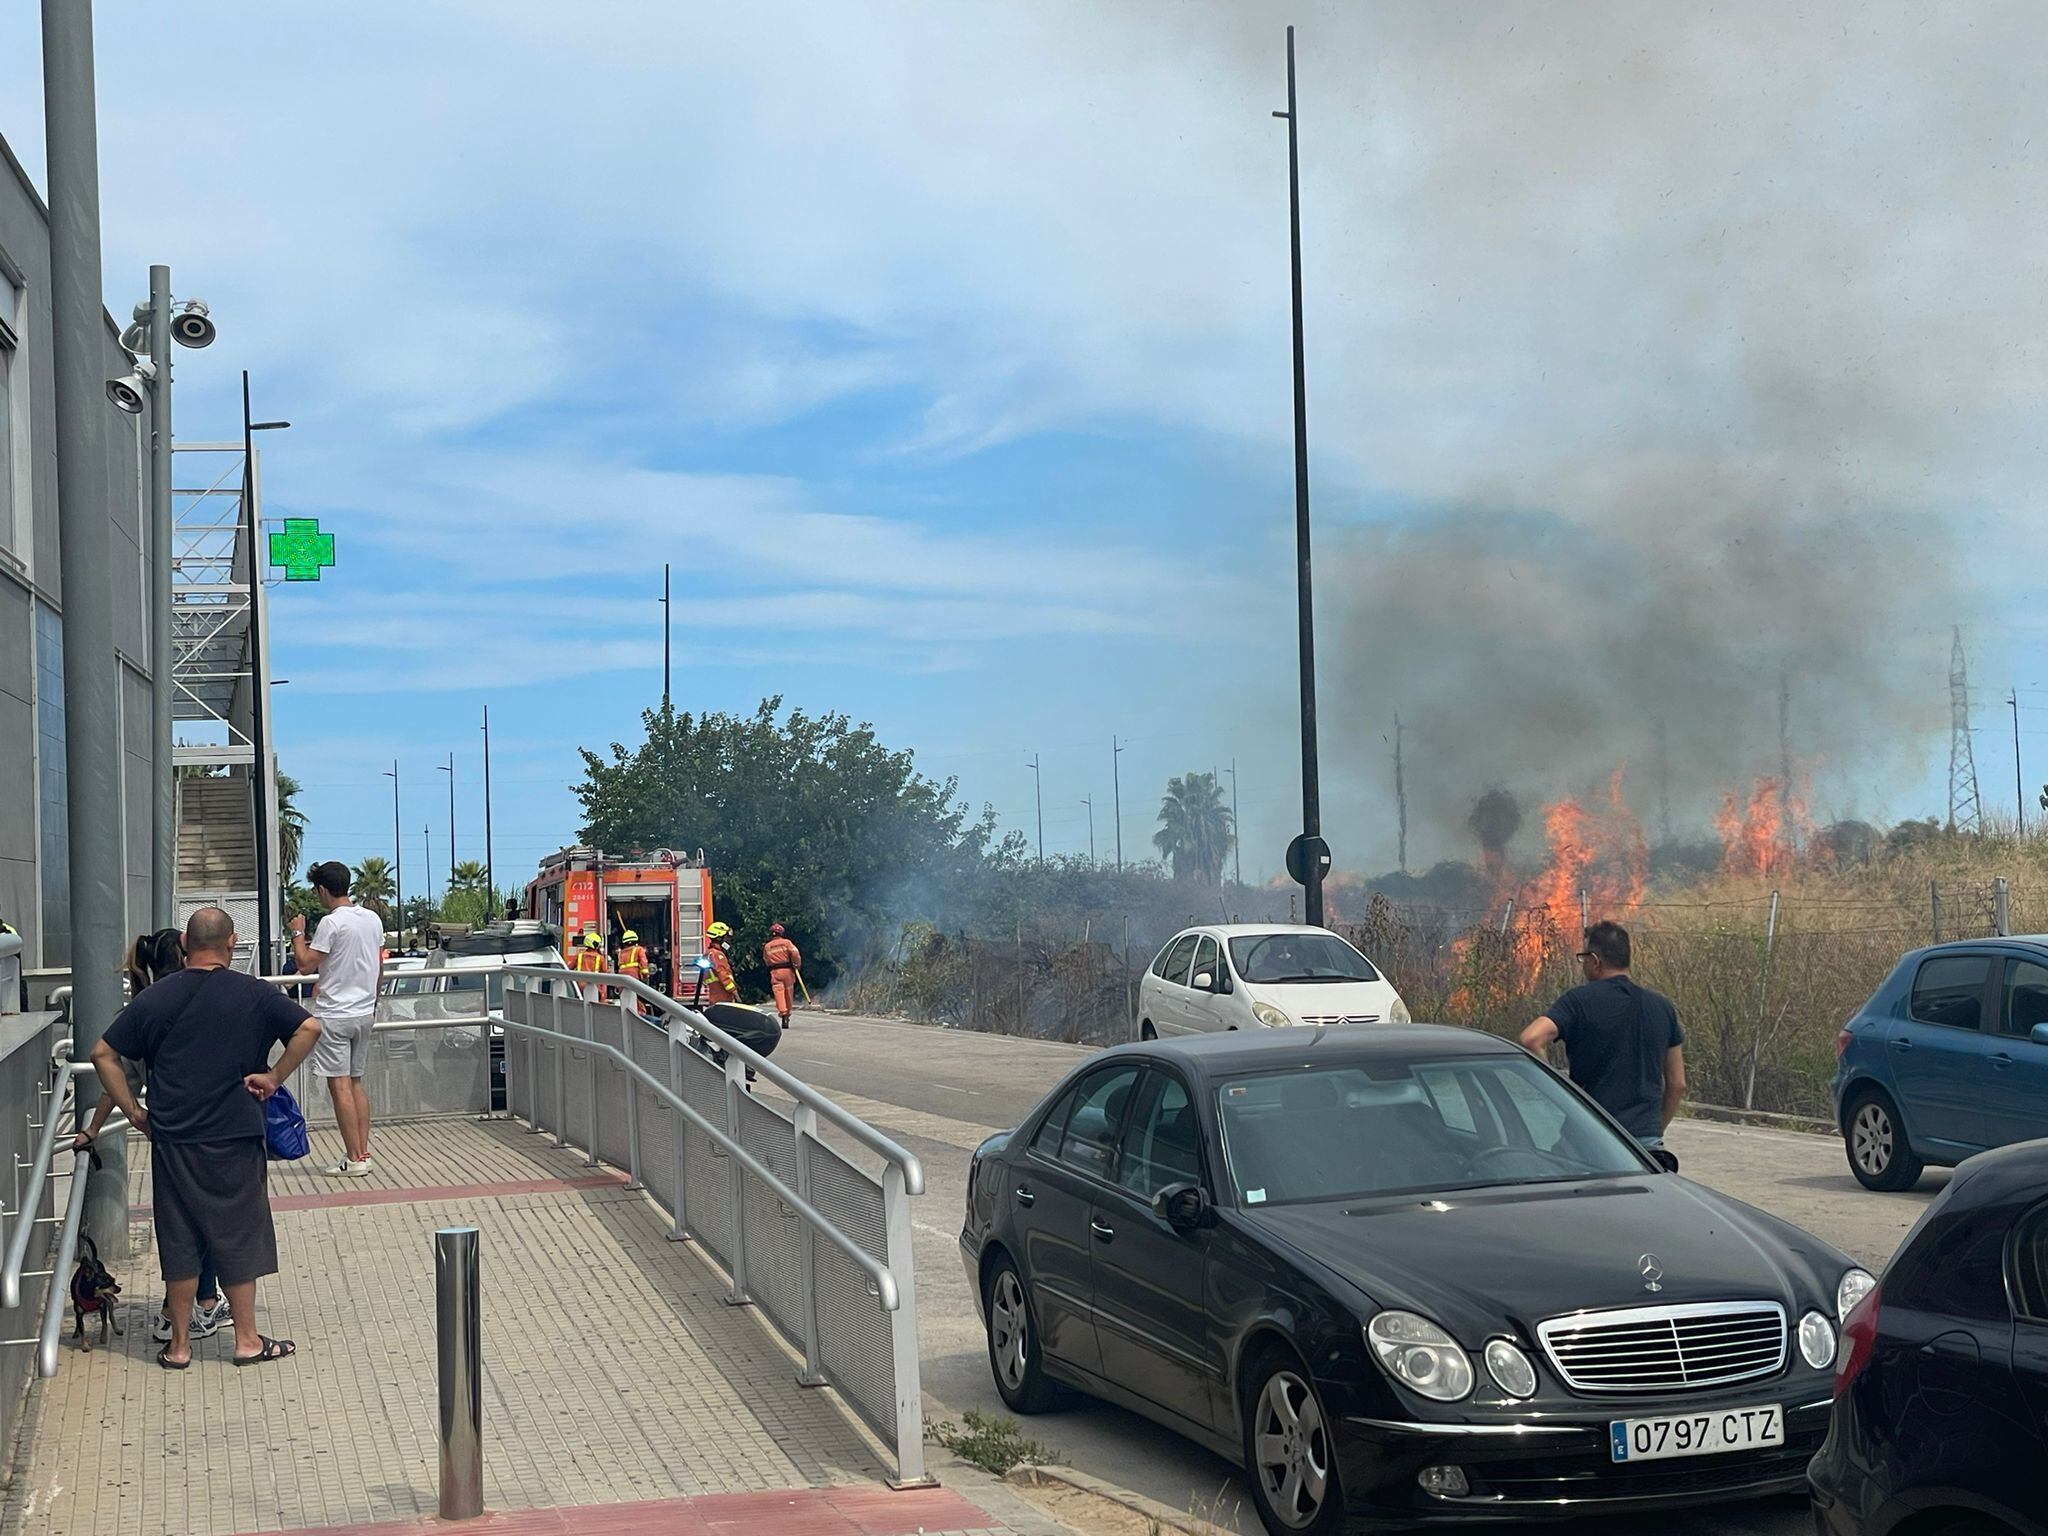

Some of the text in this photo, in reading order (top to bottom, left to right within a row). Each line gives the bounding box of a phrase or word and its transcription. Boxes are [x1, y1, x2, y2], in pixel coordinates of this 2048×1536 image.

[1634, 1409, 1776, 1453] 0797 CTZ
[1617, 1445, 1625, 1455] E
